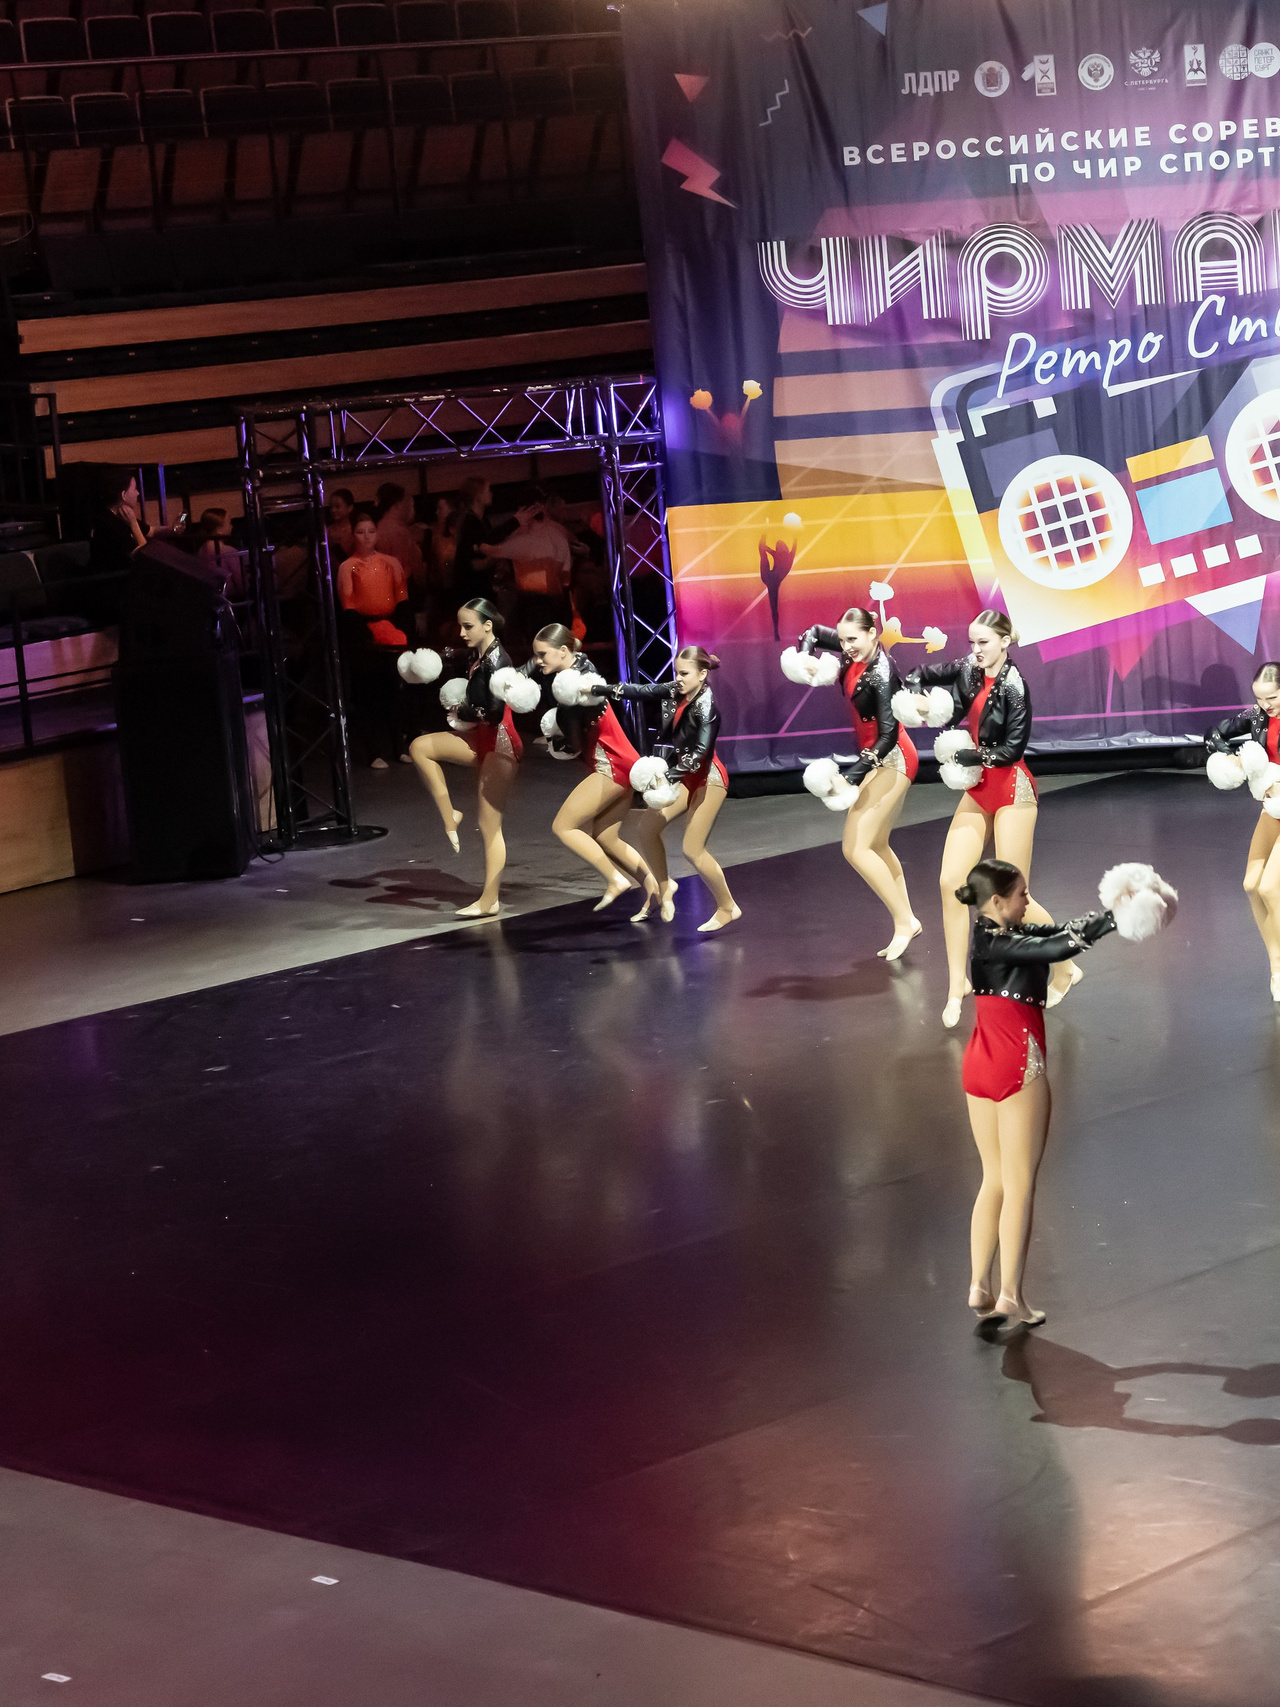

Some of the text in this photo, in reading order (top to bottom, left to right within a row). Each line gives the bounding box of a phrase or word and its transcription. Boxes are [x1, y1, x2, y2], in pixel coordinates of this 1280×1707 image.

[1254, 48, 1274, 56] САНКТ
[901, 69, 960, 97] ЛДПР
[843, 126, 1151, 166] ВСЕРОССИЙСКИЕ
[1009, 161, 1056, 184] ПО
[1071, 156, 1143, 179] ЧИР
[997, 331, 1164, 399] Ретро
